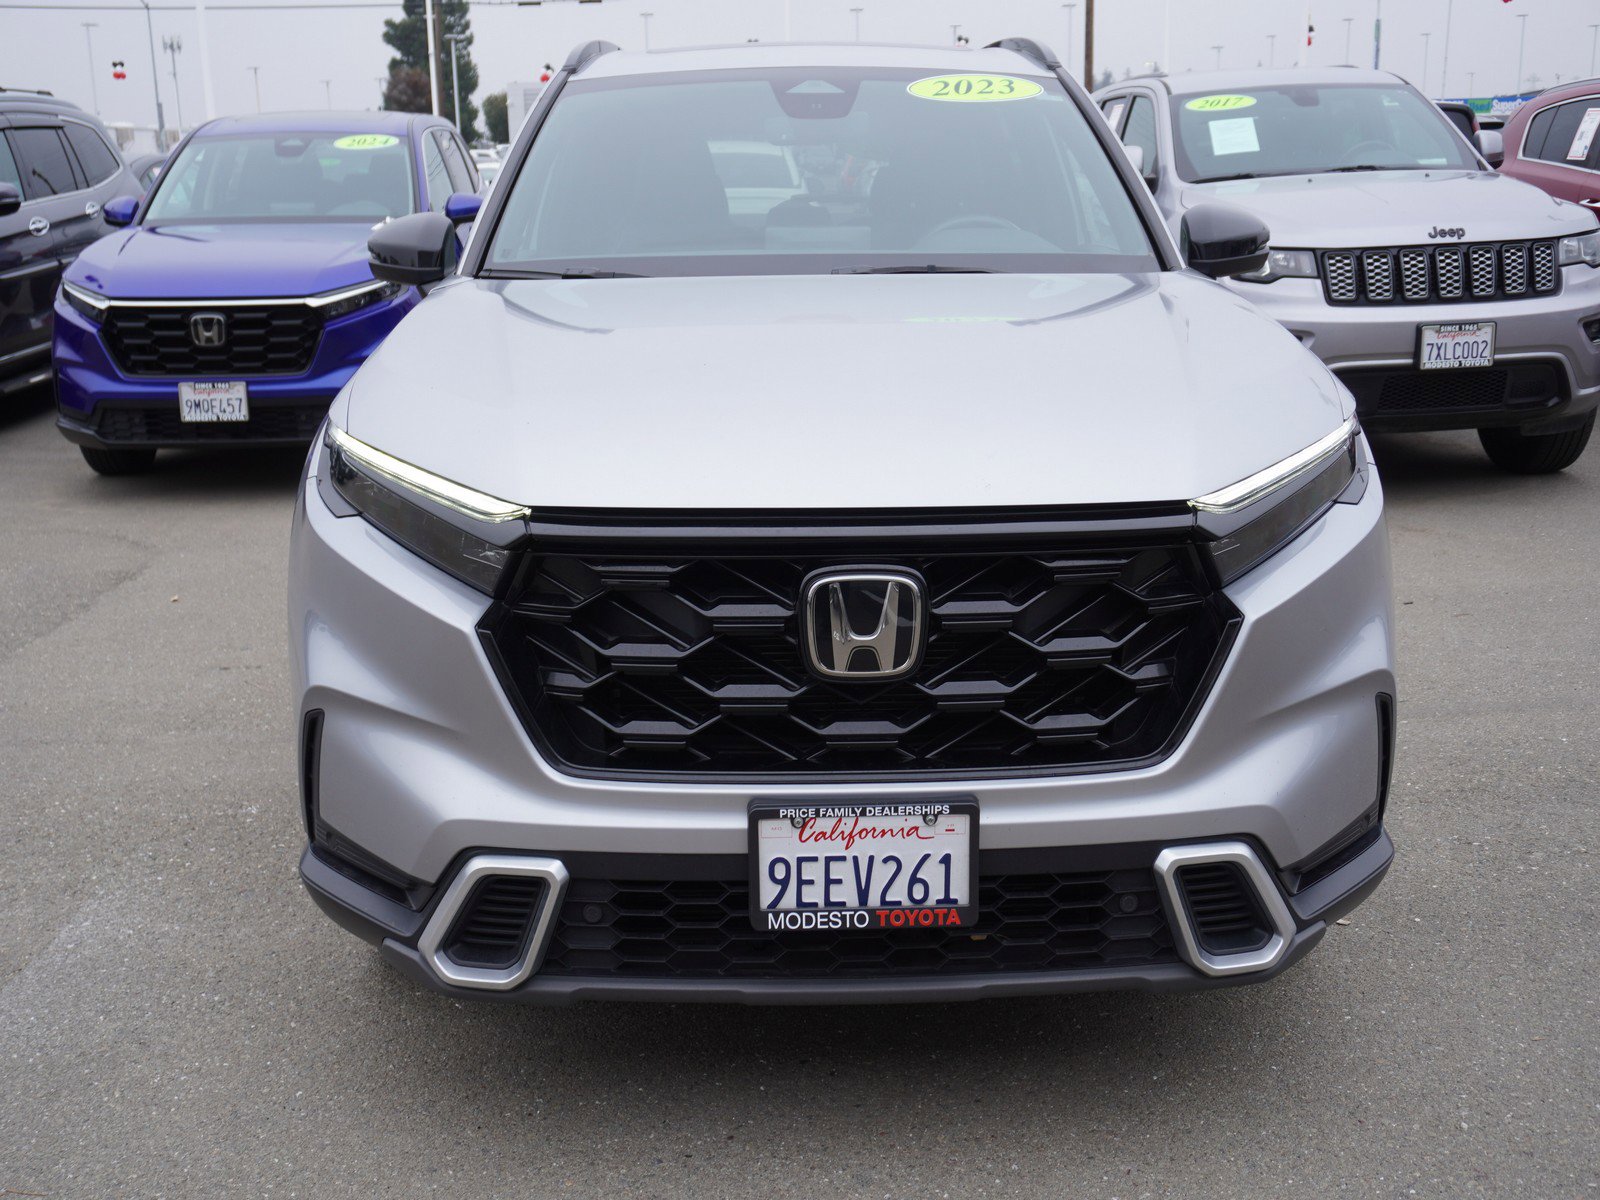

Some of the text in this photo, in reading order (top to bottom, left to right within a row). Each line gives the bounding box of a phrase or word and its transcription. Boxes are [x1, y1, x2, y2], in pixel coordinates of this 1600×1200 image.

[932, 79, 1014, 96] 2023
[1198, 97, 1244, 109] 2017
[1428, 226, 1466, 240] Jeep
[1426, 340, 1489, 361] 7XLC002
[1461, 359, 1489, 367] TOYOTA
[779, 805, 950, 818] PRICE FAMILY DEALERSHIPS
[798, 816, 935, 850] California
[767, 853, 959, 909] 9EEV261
[768, 909, 961, 929] MODESTO TOYOTA
